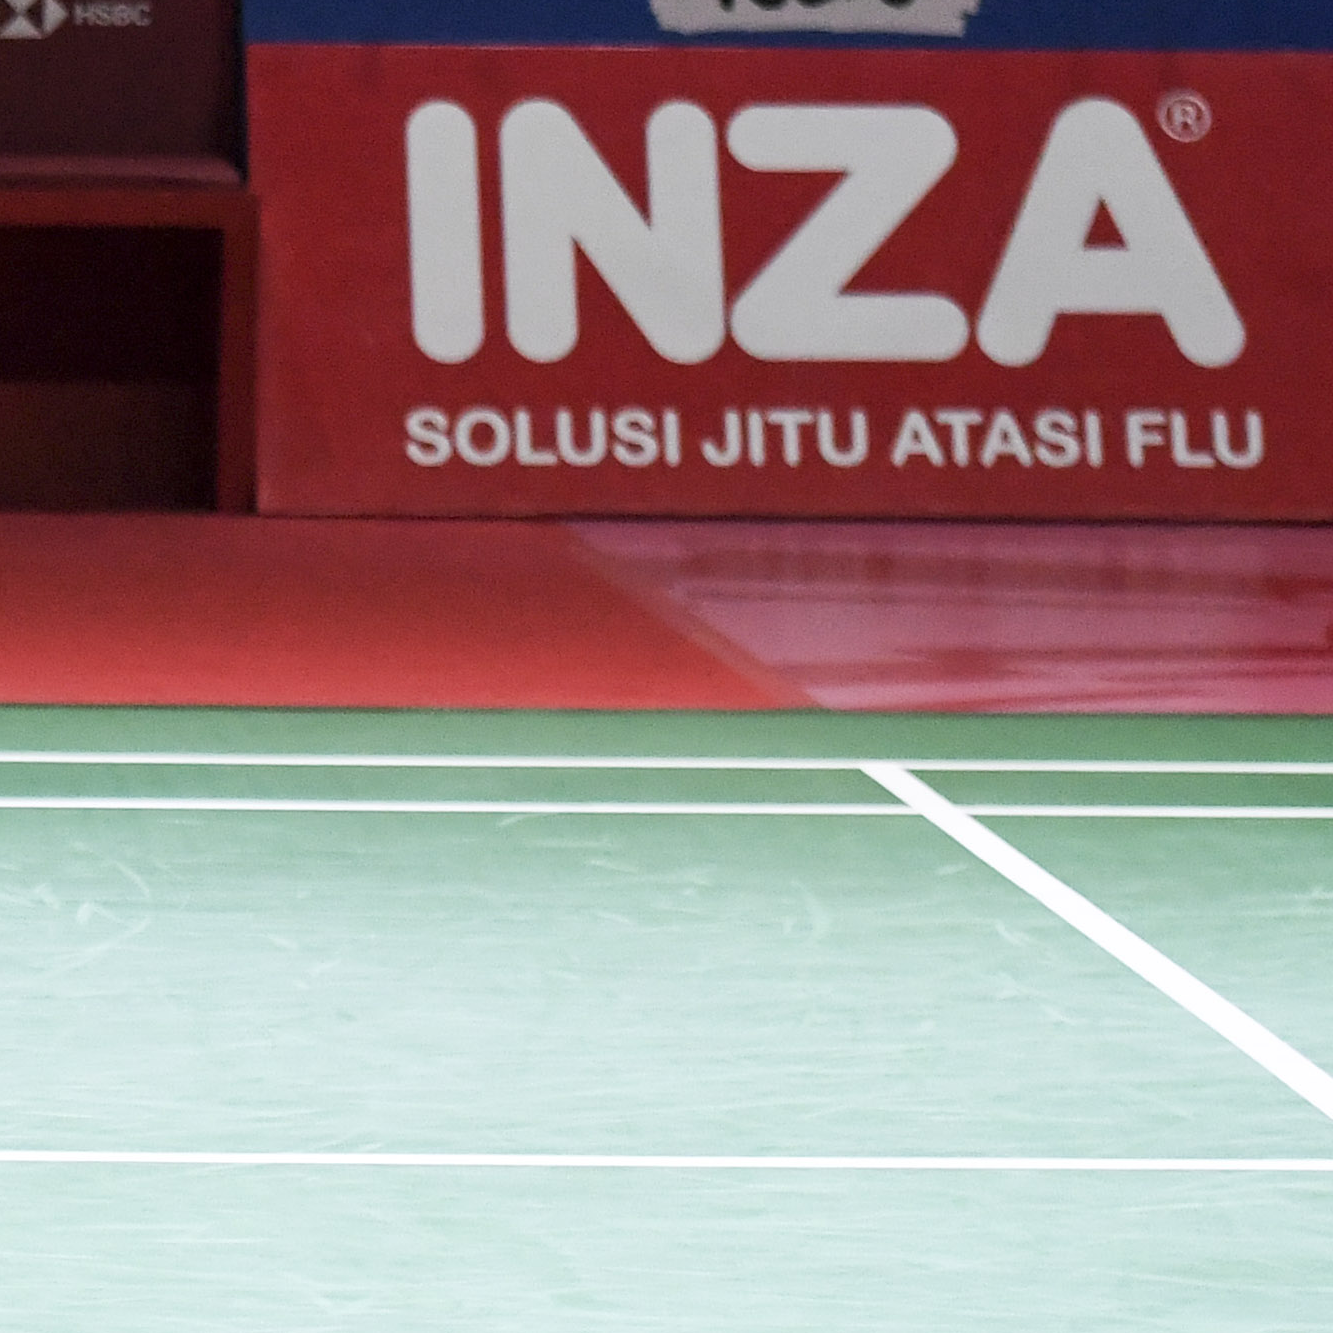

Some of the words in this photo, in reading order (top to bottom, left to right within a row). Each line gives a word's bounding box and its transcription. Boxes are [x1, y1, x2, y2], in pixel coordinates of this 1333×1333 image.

[73, 2, 153, 27] HSBC
[405, 97, 1247, 368] INZA
[405, 406, 683, 468] SOLUSI
[700, 407, 871, 468] JITU
[890, 408, 1104, 468] ATASI
[1125, 408, 1265, 469] FLU
